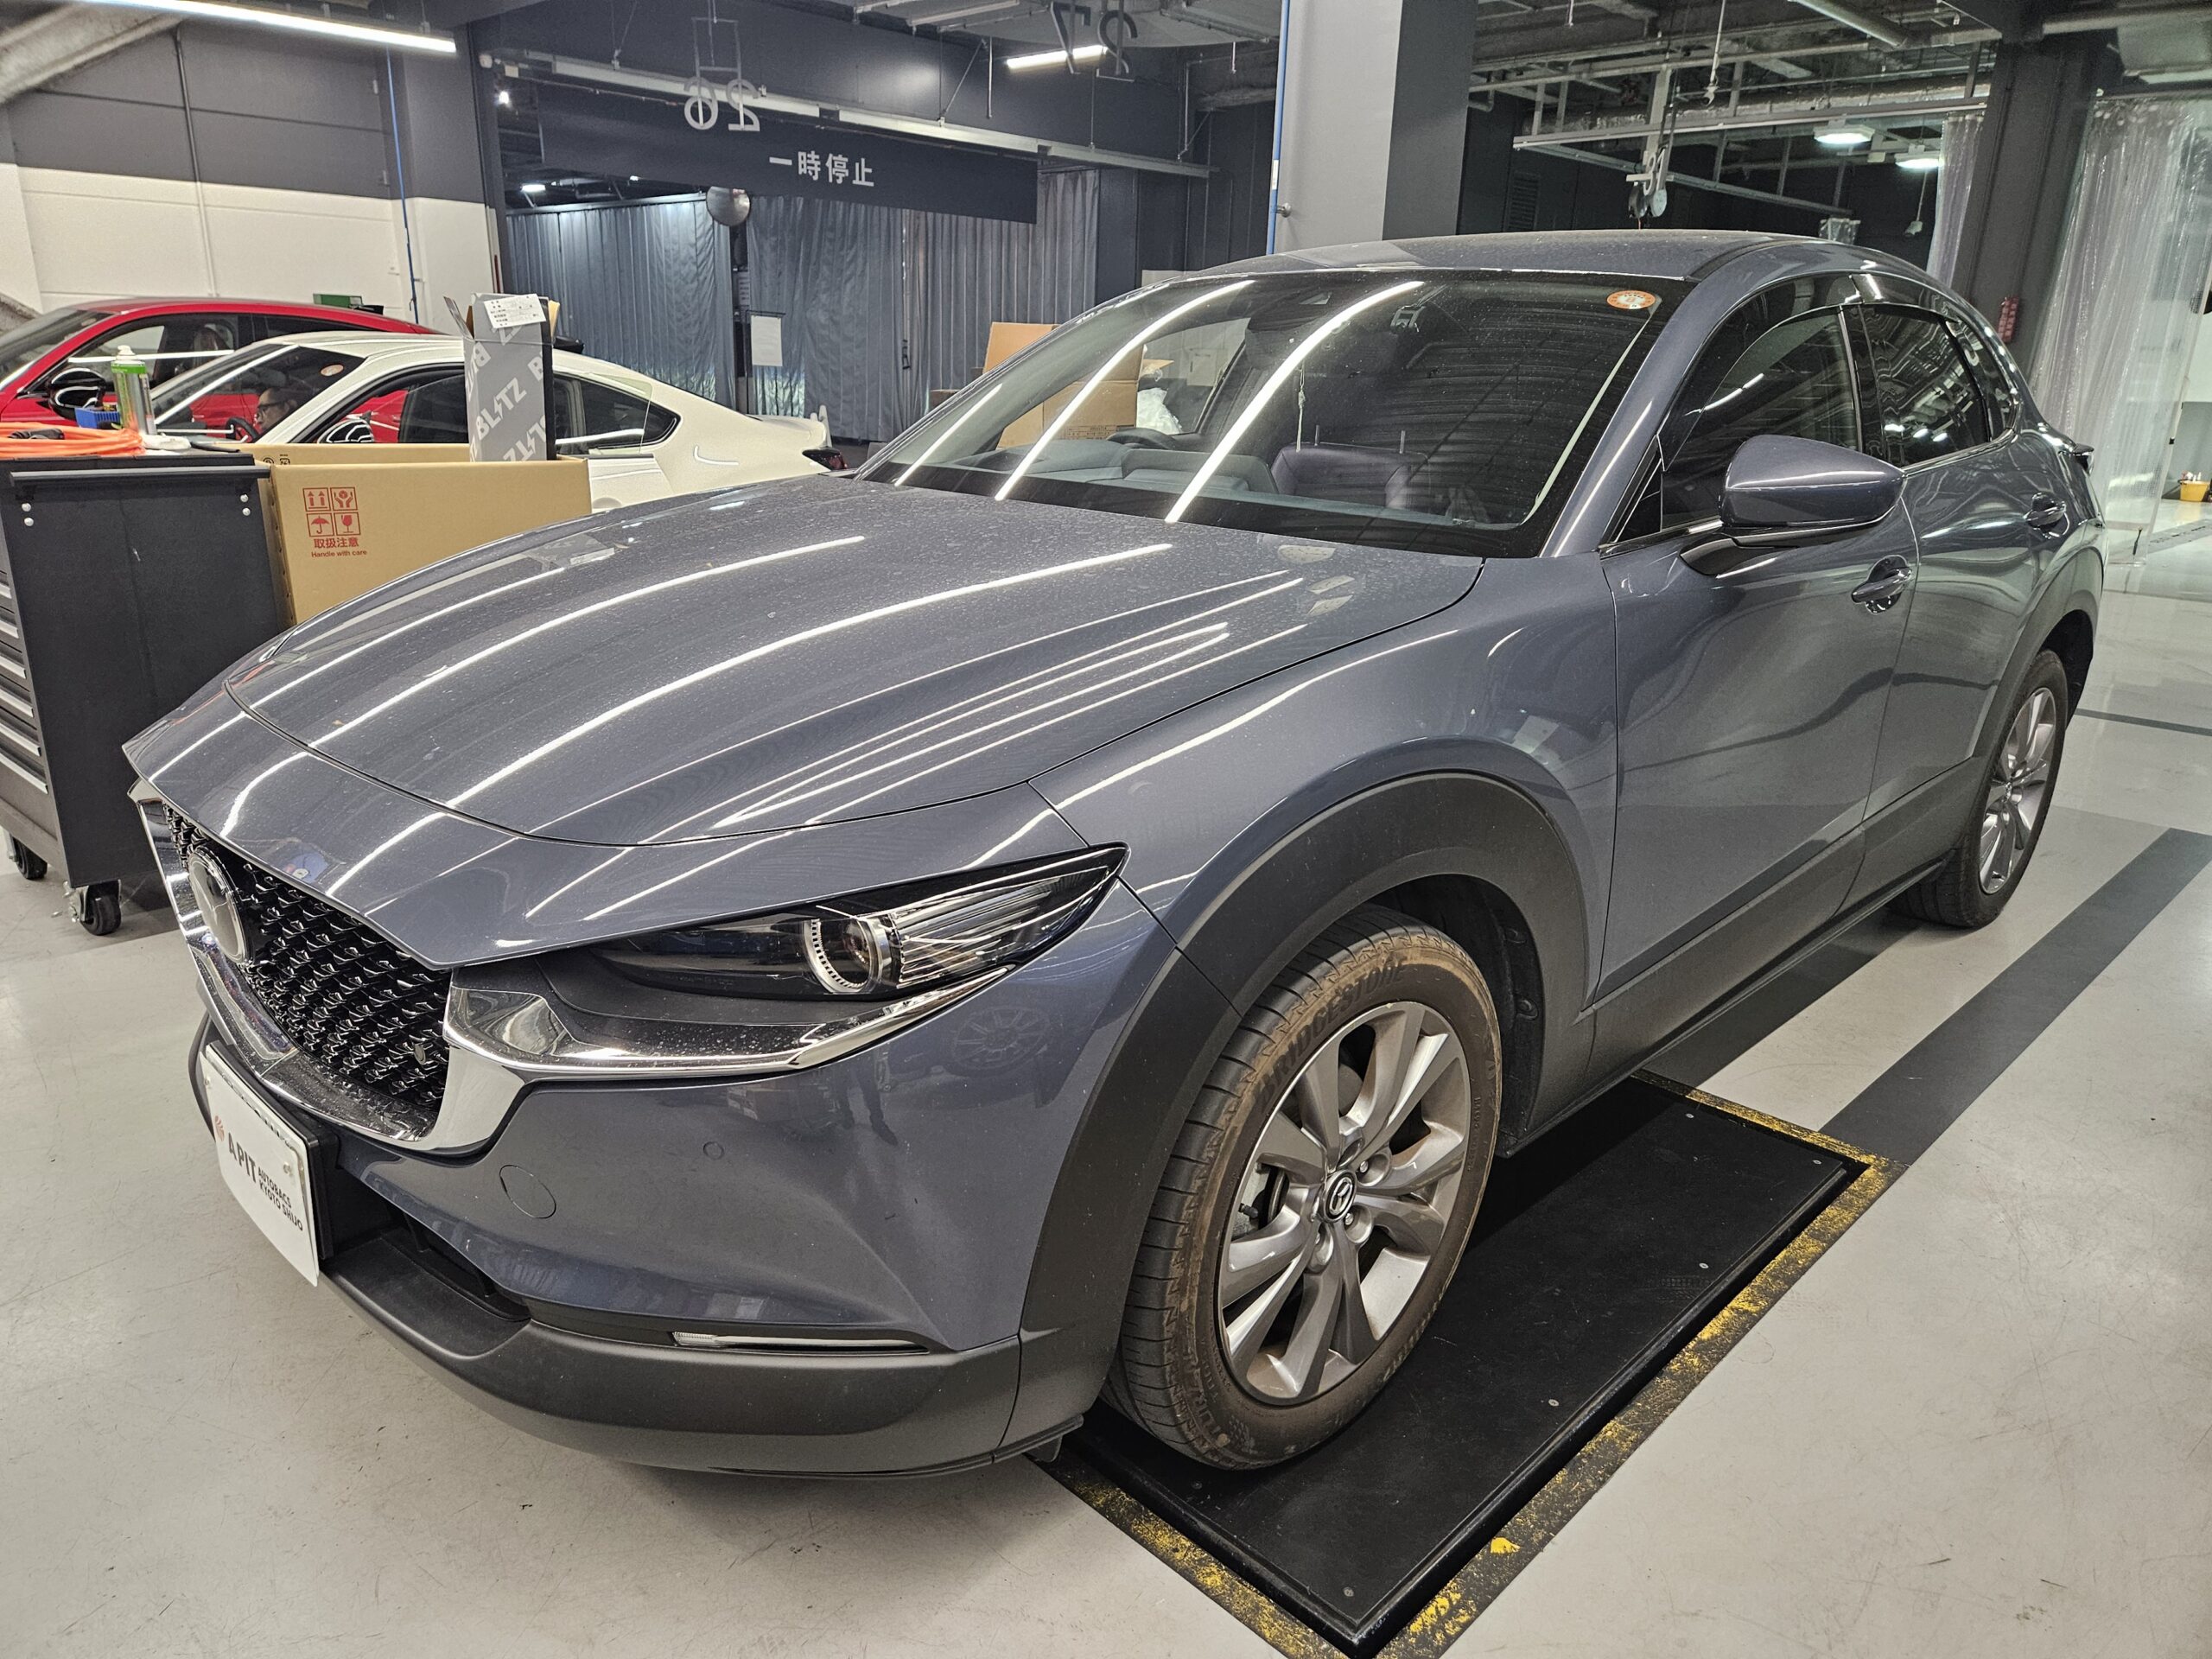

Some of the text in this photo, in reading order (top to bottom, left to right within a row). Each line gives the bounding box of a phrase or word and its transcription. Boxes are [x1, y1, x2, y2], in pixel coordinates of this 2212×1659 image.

[769, 150, 874, 187] 一時停止
[476, 378, 527, 441] BLITZ
[314, 537, 359, 549] 取扱注意
[1254, 952, 1409, 1113] BRIDGESTONE
[257, 1166, 292, 1209] AUTOBACS
[259, 1179, 303, 1231] KYOTO SHIJO
